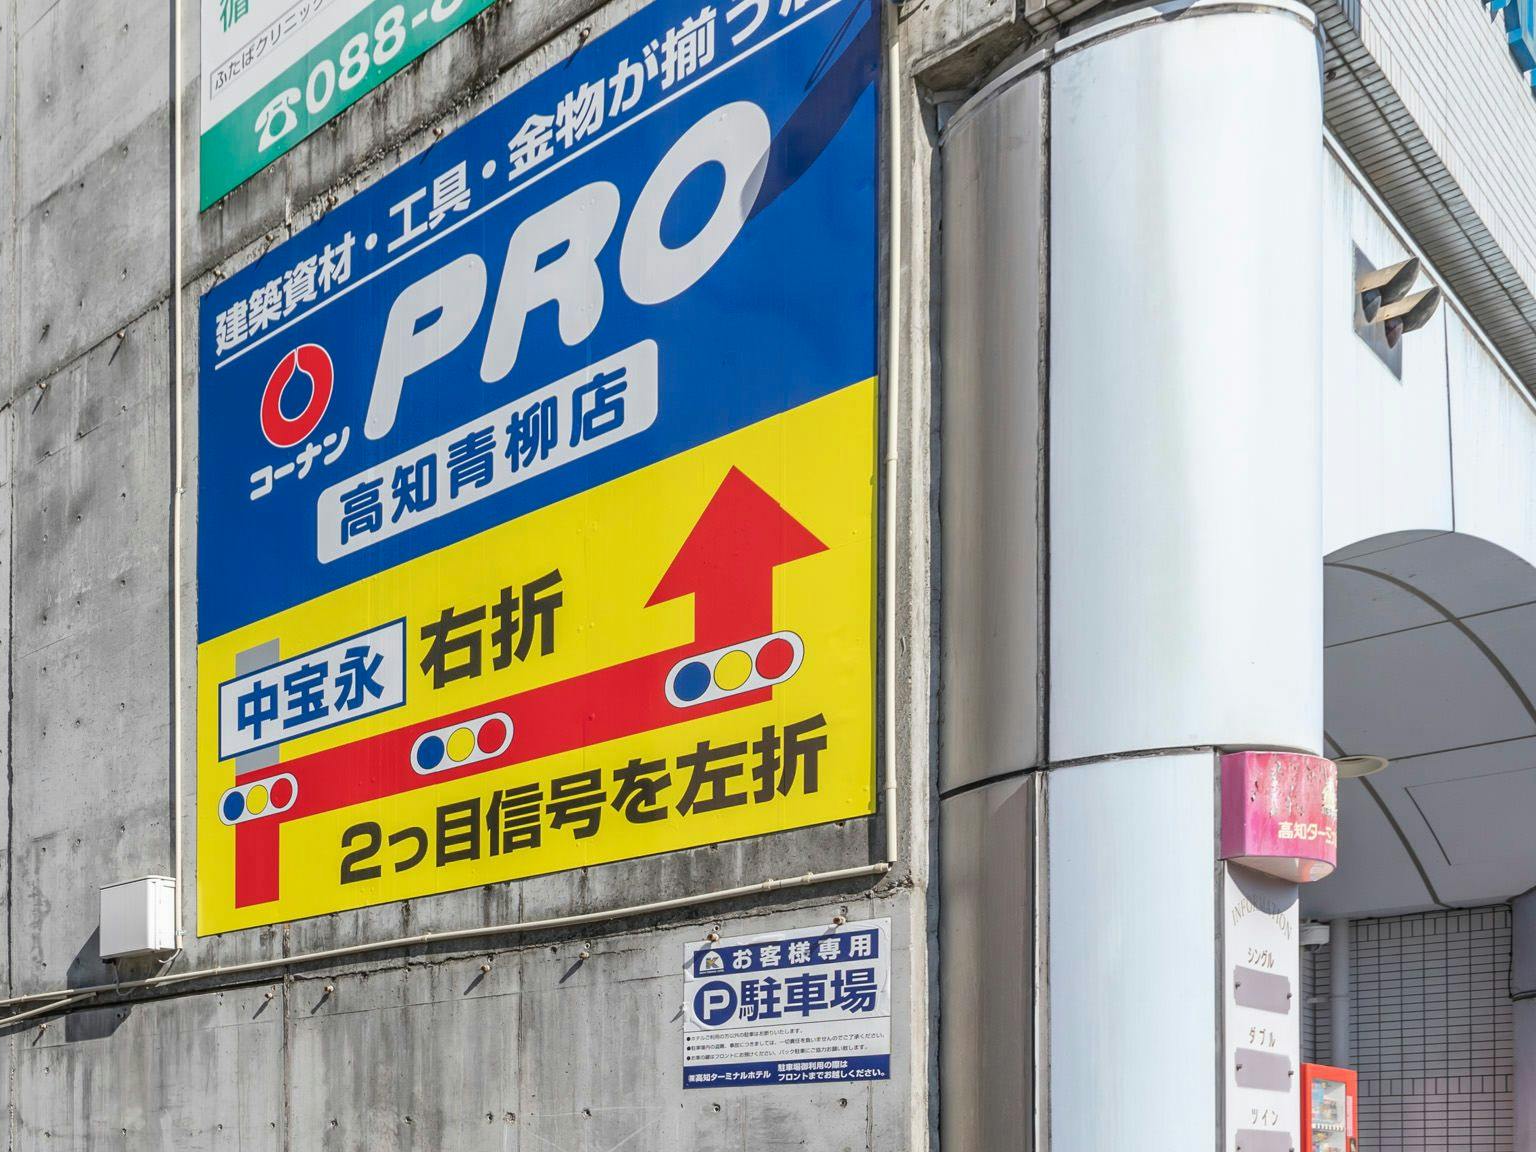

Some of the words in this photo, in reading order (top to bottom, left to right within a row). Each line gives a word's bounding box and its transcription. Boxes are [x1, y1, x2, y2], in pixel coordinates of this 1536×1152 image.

[215, 0, 807, 357] 建築資材・工具・金物が揃う
[364, 100, 772, 441] PRO
[249, 425, 351, 501] コーナン
[339, 365, 630, 546] 高知青柳店
[419, 567, 564, 691] 右折
[236, 644, 385, 741] 中宝永
[732, 933, 872, 971] お客様専用
[1248, 947, 1275, 969] シングル
[739, 967, 878, 1022] 駐車場
[1249, 1026, 1277, 1048] ダブル
[1251, 1107, 1279, 1127] ツイン
